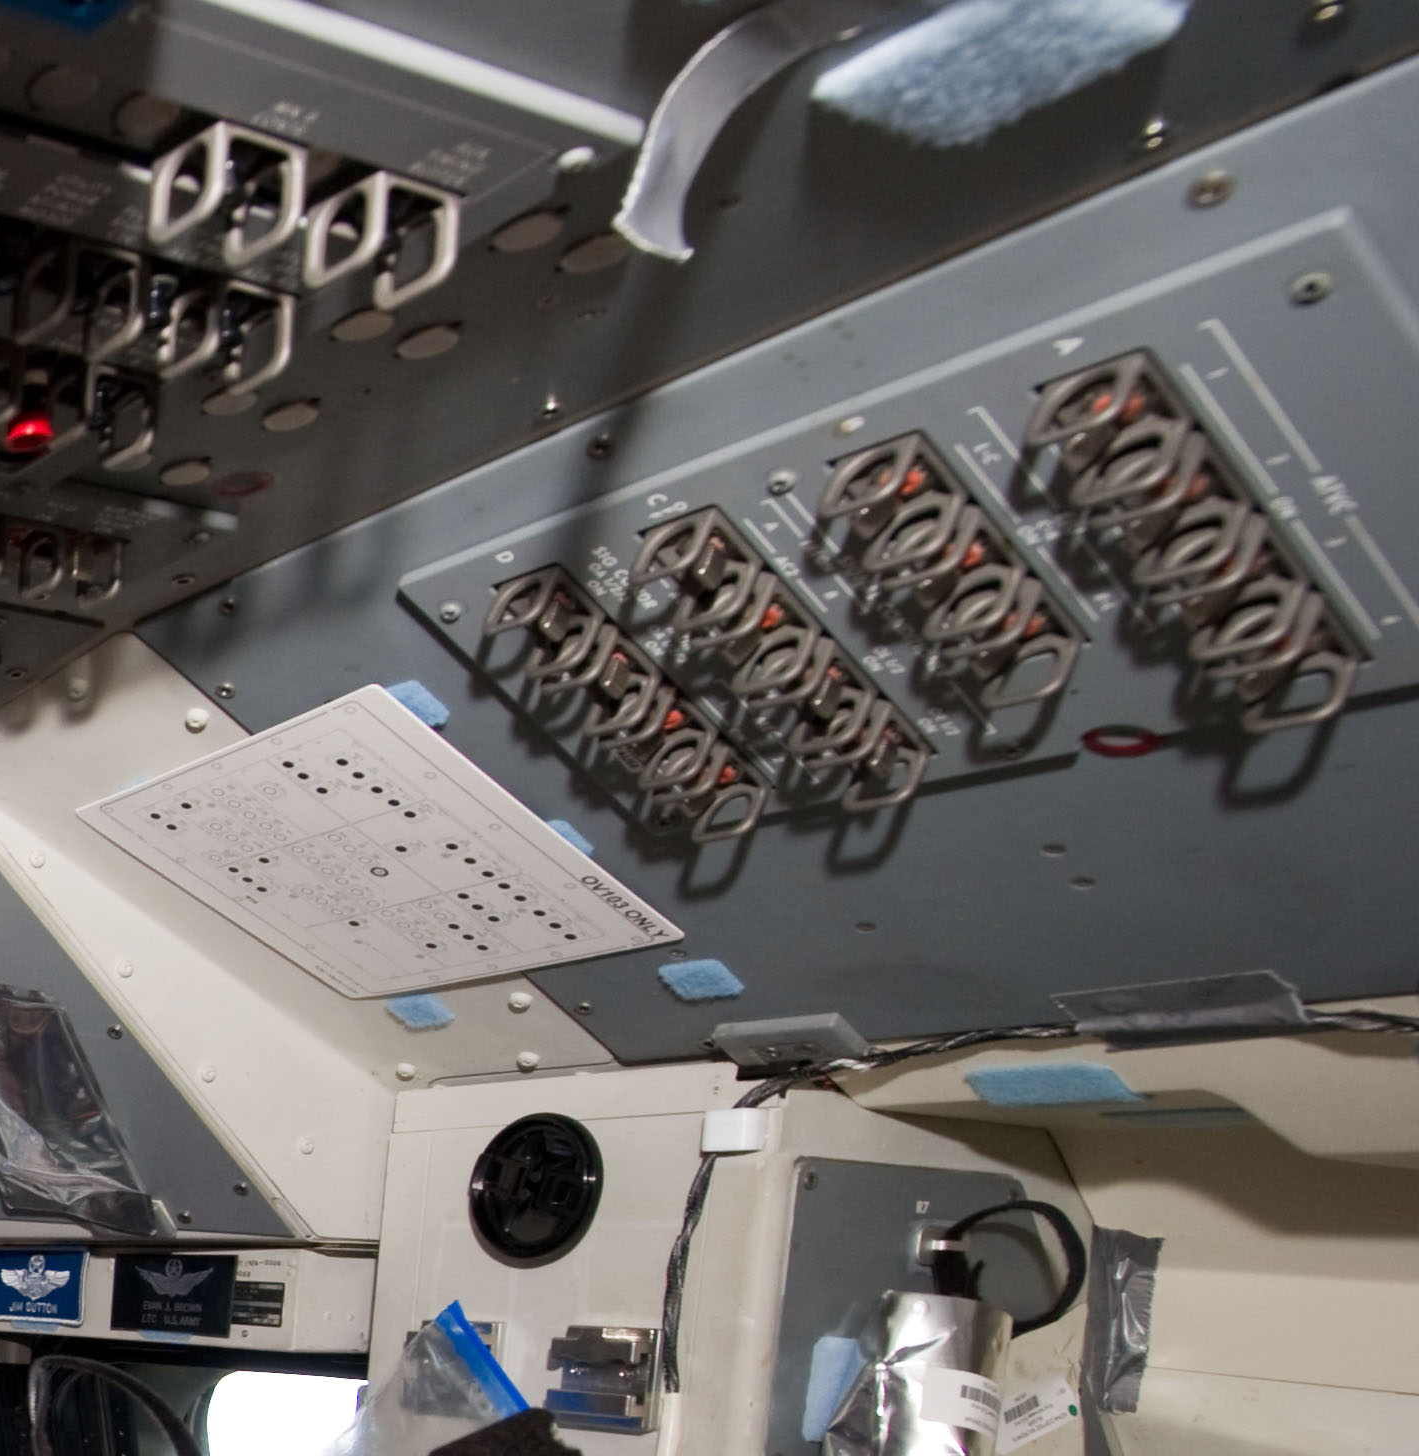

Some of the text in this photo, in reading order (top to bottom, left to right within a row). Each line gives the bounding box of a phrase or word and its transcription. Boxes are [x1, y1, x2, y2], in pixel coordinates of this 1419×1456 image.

[581, 875, 671, 938] OV103 ONLY
[9, 1300, 59, 1315] JIM DUTTON
[142, 1300, 203, 1313] EVAN BROWN
[141, 1314, 158, 1325] LTC
